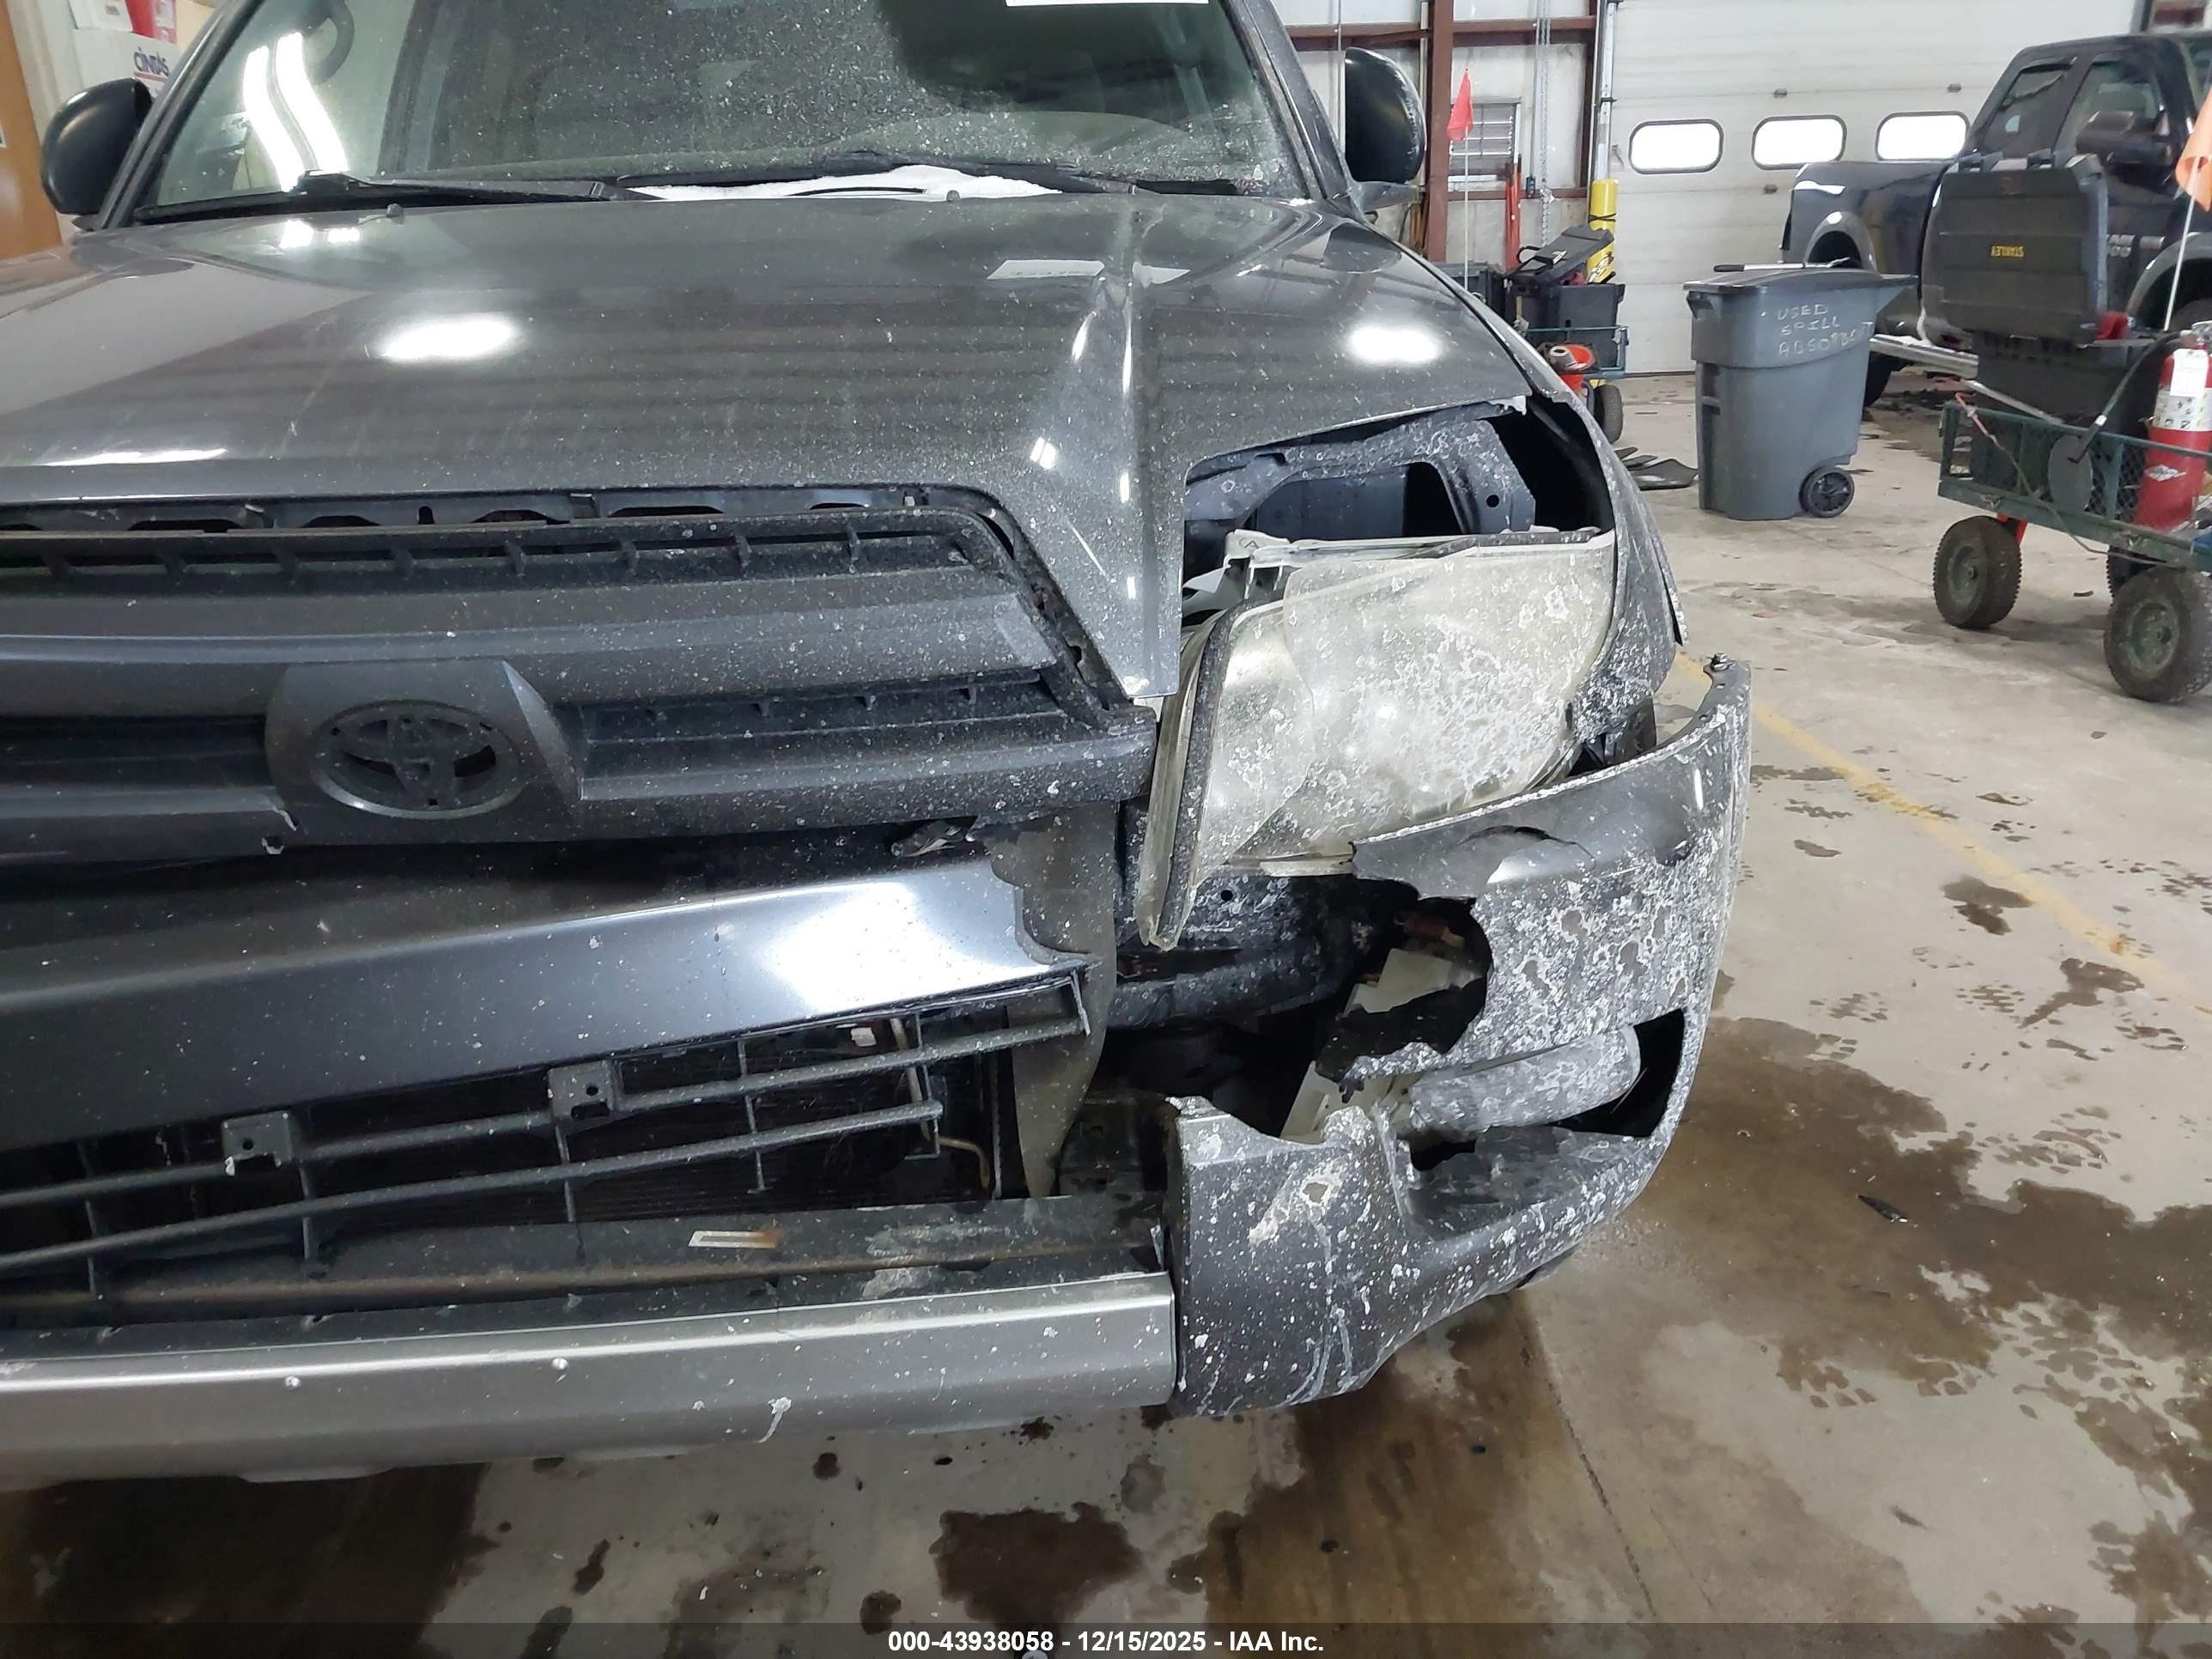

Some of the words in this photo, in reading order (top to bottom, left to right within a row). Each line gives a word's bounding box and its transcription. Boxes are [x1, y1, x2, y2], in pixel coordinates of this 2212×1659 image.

[133, 47, 170, 76] CINTAS
[1777, 303, 1828, 320] USED
[1780, 315, 1840, 336] SPILL
